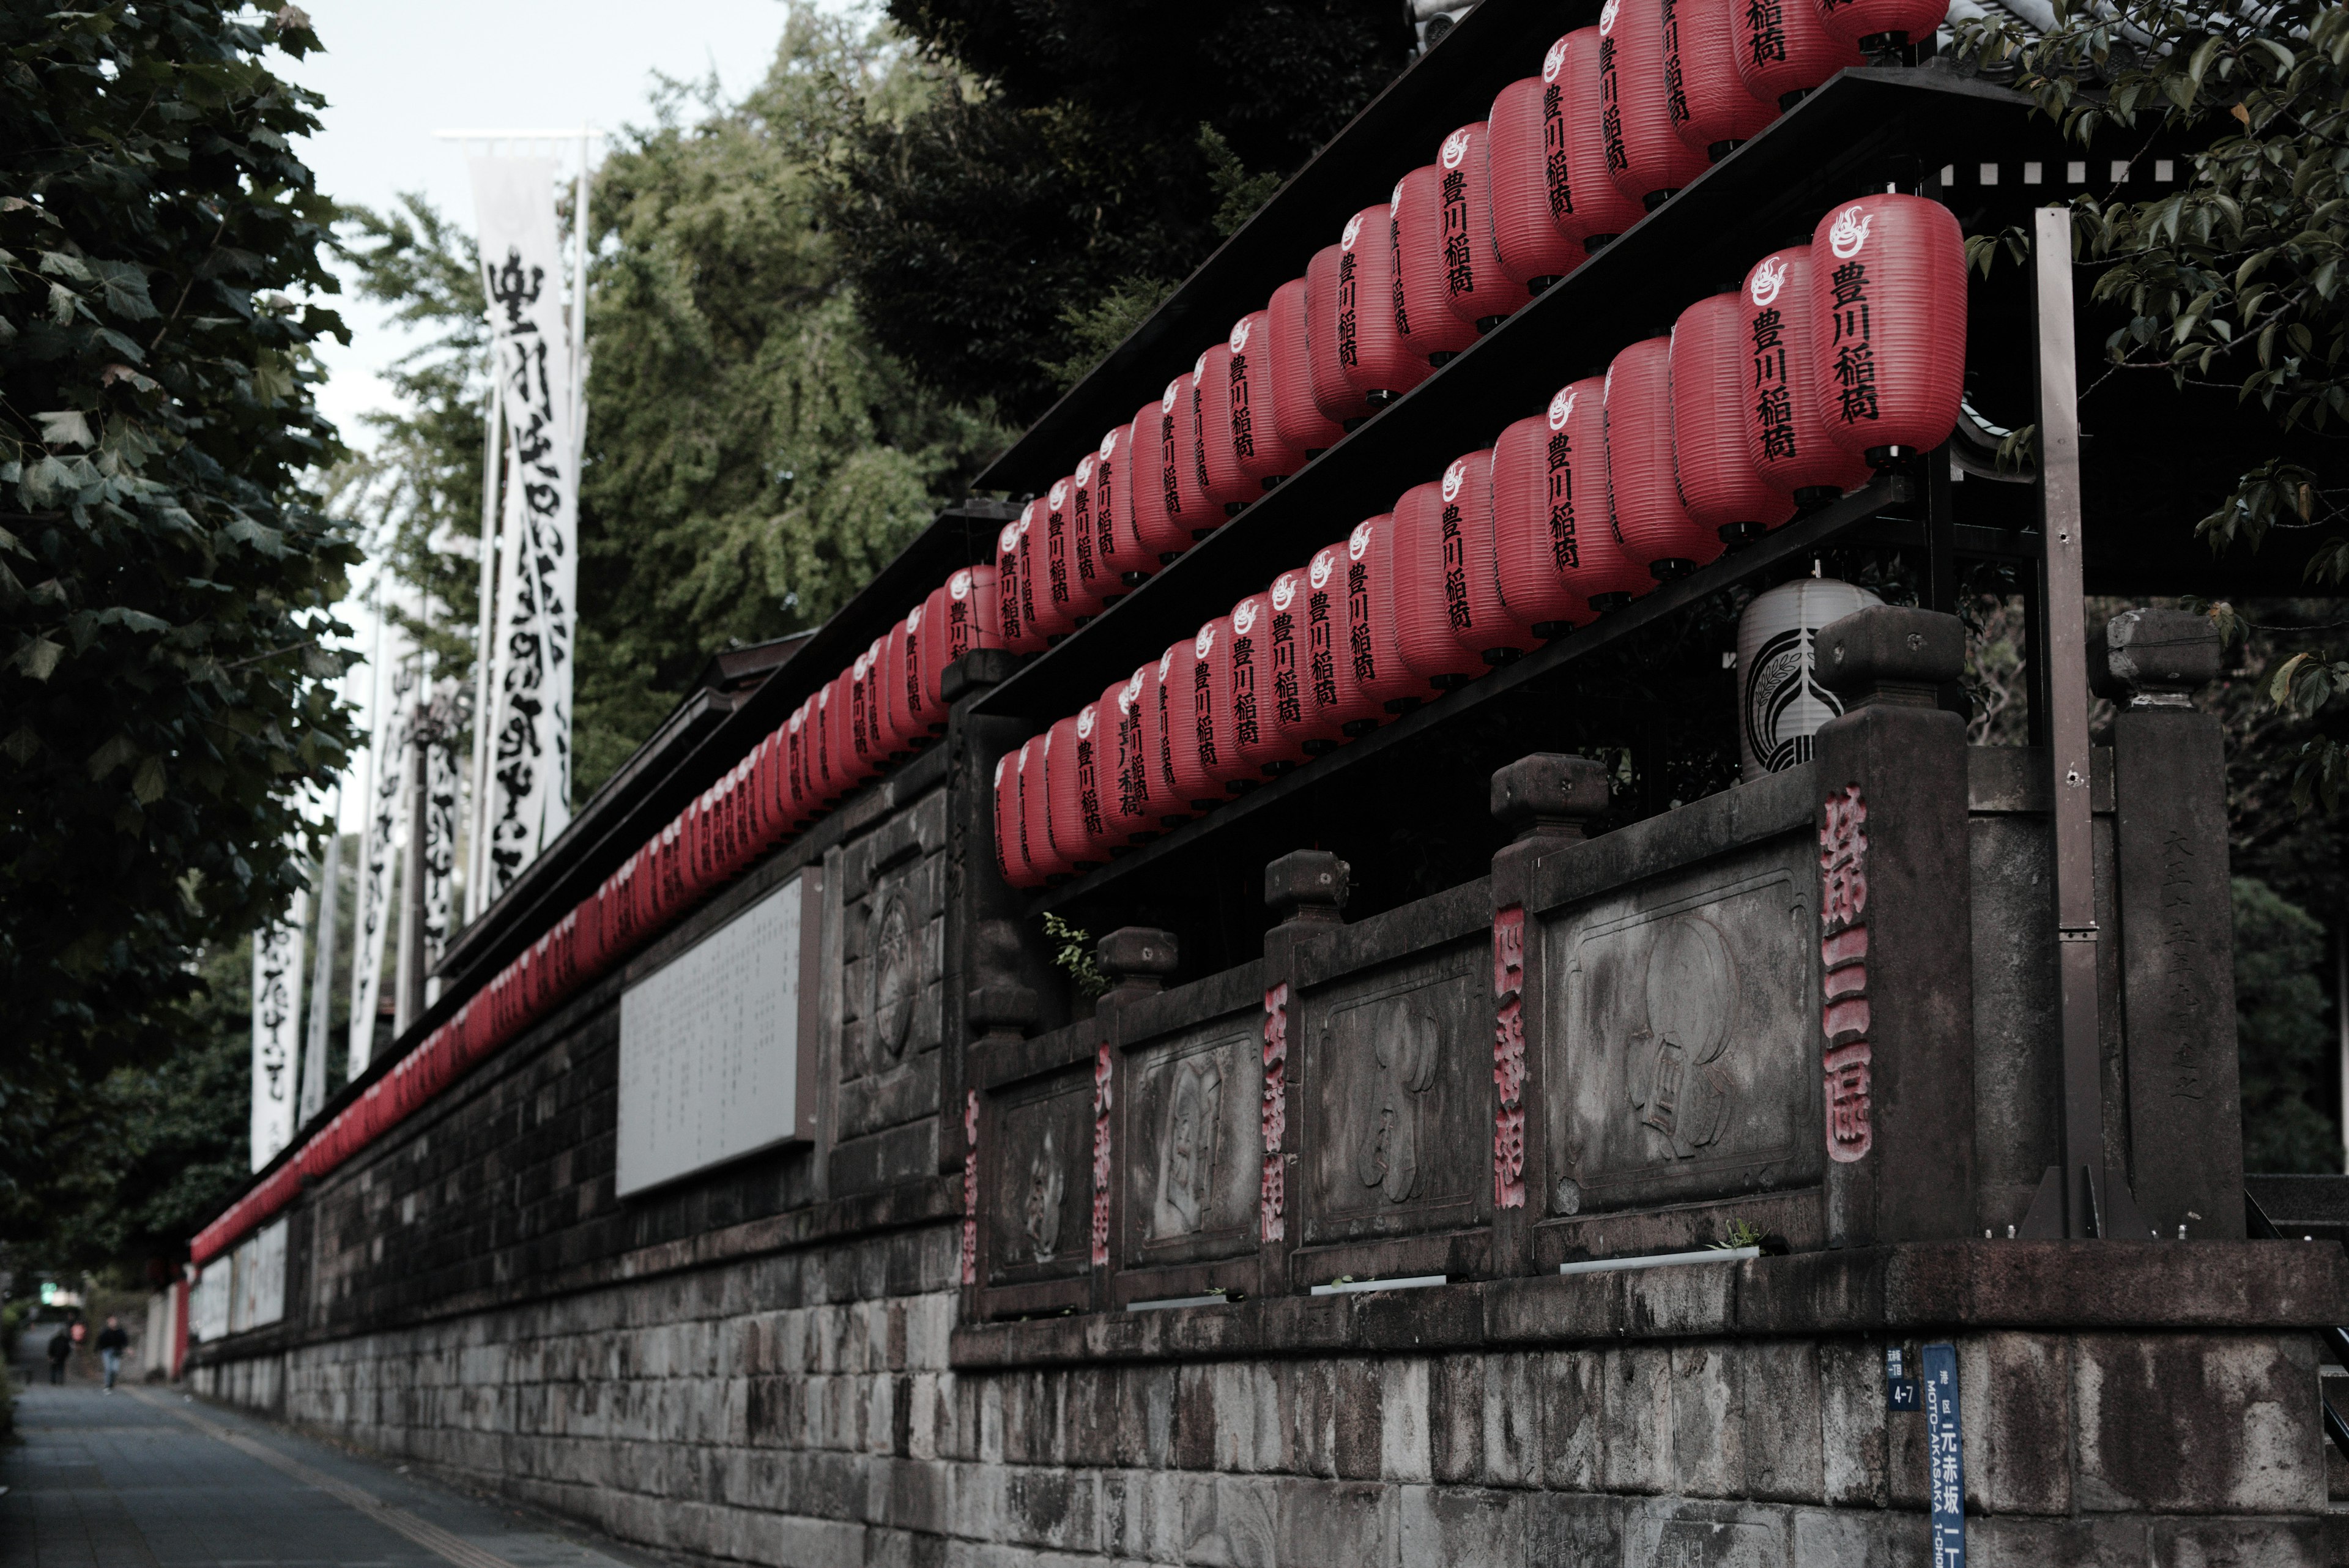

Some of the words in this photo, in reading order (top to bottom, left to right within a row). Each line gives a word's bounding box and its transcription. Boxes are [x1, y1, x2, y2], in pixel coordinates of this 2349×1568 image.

[1543, 83, 1573, 220] 豊川稲荷
[1598, 35, 1628, 176] 豊川稲荷
[1442, 169, 1474, 297] 豊川稲荷
[1338, 251, 1358, 371] 豊川稲荷
[1830, 261, 1879, 425] 豊川稲荷
[1230, 353, 1255, 461] 豊川稲荷
[1752, 307, 1796, 463] 豊川稲荷
[1097, 461, 1115, 557] 豊川稲荷
[1162, 414, 1181, 515] 豊川稲荷
[1547, 433, 1579, 573] 豊川稲荷
[1021, 533, 1036, 623] 豊川稲荷
[1048, 511, 1069, 604] 豊川稲荷
[1075, 488, 1095, 582] 豊川稲荷
[1442, 503, 1472, 631] 豊川稲荷
[1001, 552, 1021, 640] 豊川稲荷
[1309, 590, 1338, 707] 豊川稲荷
[1348, 562, 1376, 683] 豊川稲荷
[1195, 661, 1217, 767] 豊川稲荷
[1232, 636, 1259, 746] 豊川稲荷
[1272, 612, 1301, 724] 豊川稲荷
[1077, 740, 1103, 836] 豊川稲荷
[1129, 702, 1149, 803] 豊川稲荷
[1894, 1386, 1913, 1403] 4-7
[1940, 1370, 1951, 1414] 港区
[1928, 1380, 1942, 1513] MOTO-AKASAKA
[1935, 1523, 1944, 1568] 1-CHO
